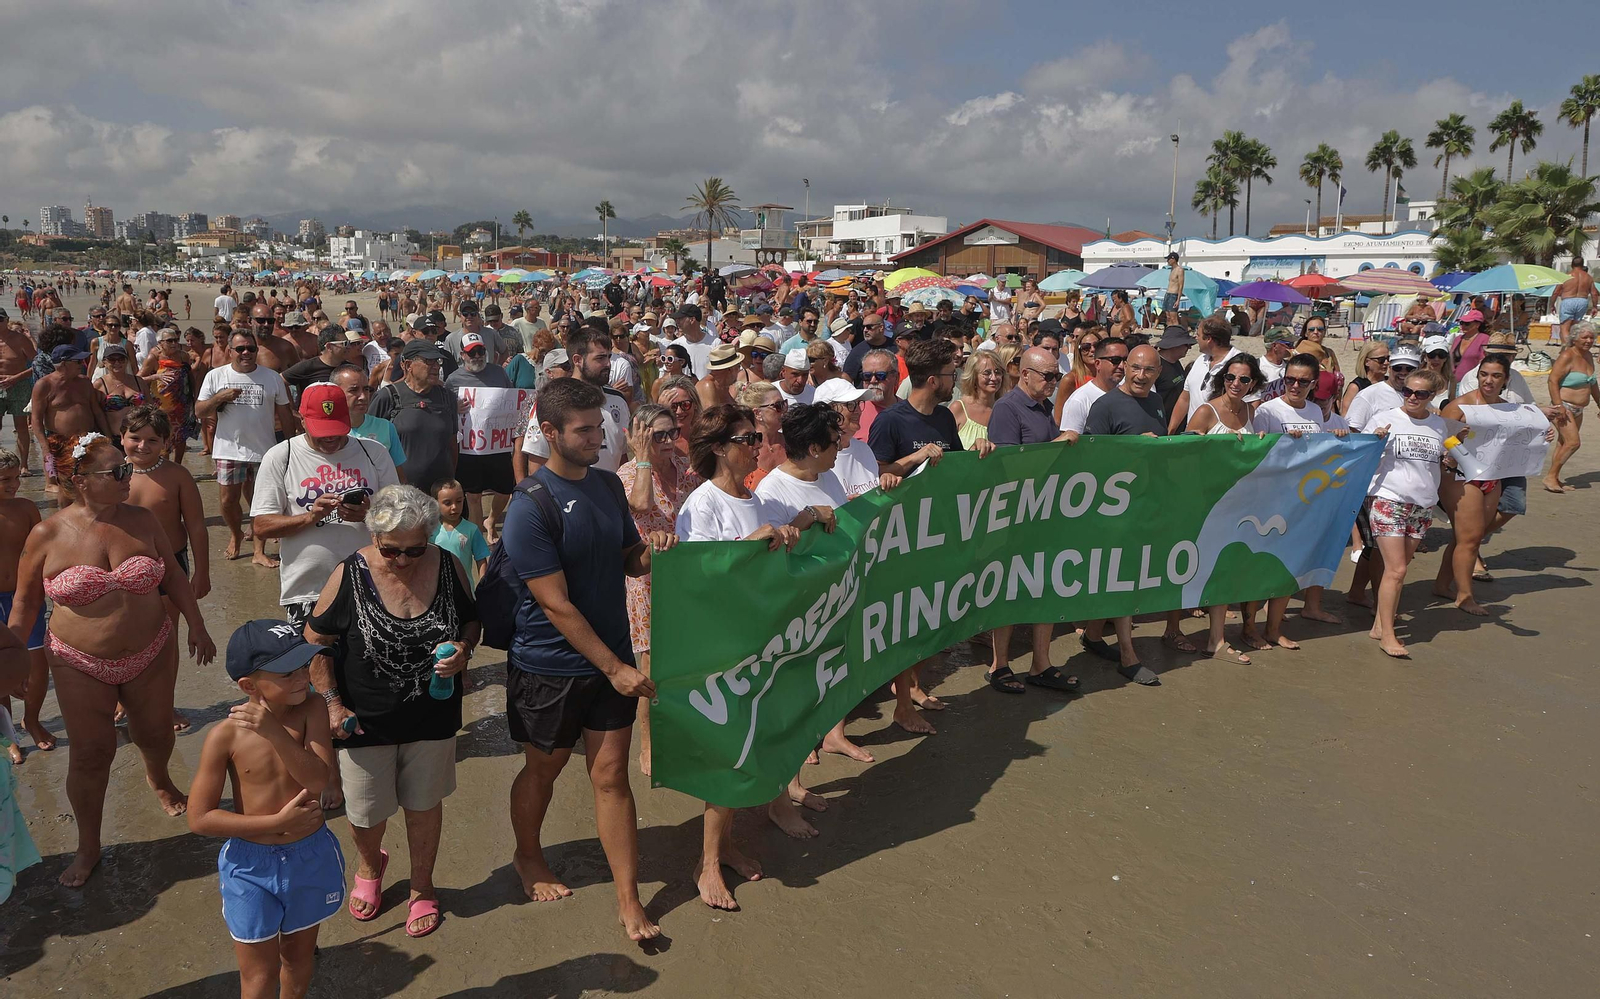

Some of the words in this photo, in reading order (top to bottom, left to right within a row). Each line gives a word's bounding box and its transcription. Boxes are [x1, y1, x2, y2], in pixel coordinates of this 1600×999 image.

[1398, 346, 1412, 355] NY
[461, 428, 487, 451] LOS
[296, 468, 370, 507] Beach
[316, 463, 353, 485] Palm
[864, 471, 1138, 577] SALVEMOS
[863, 540, 1199, 663] RINCONCILLO
